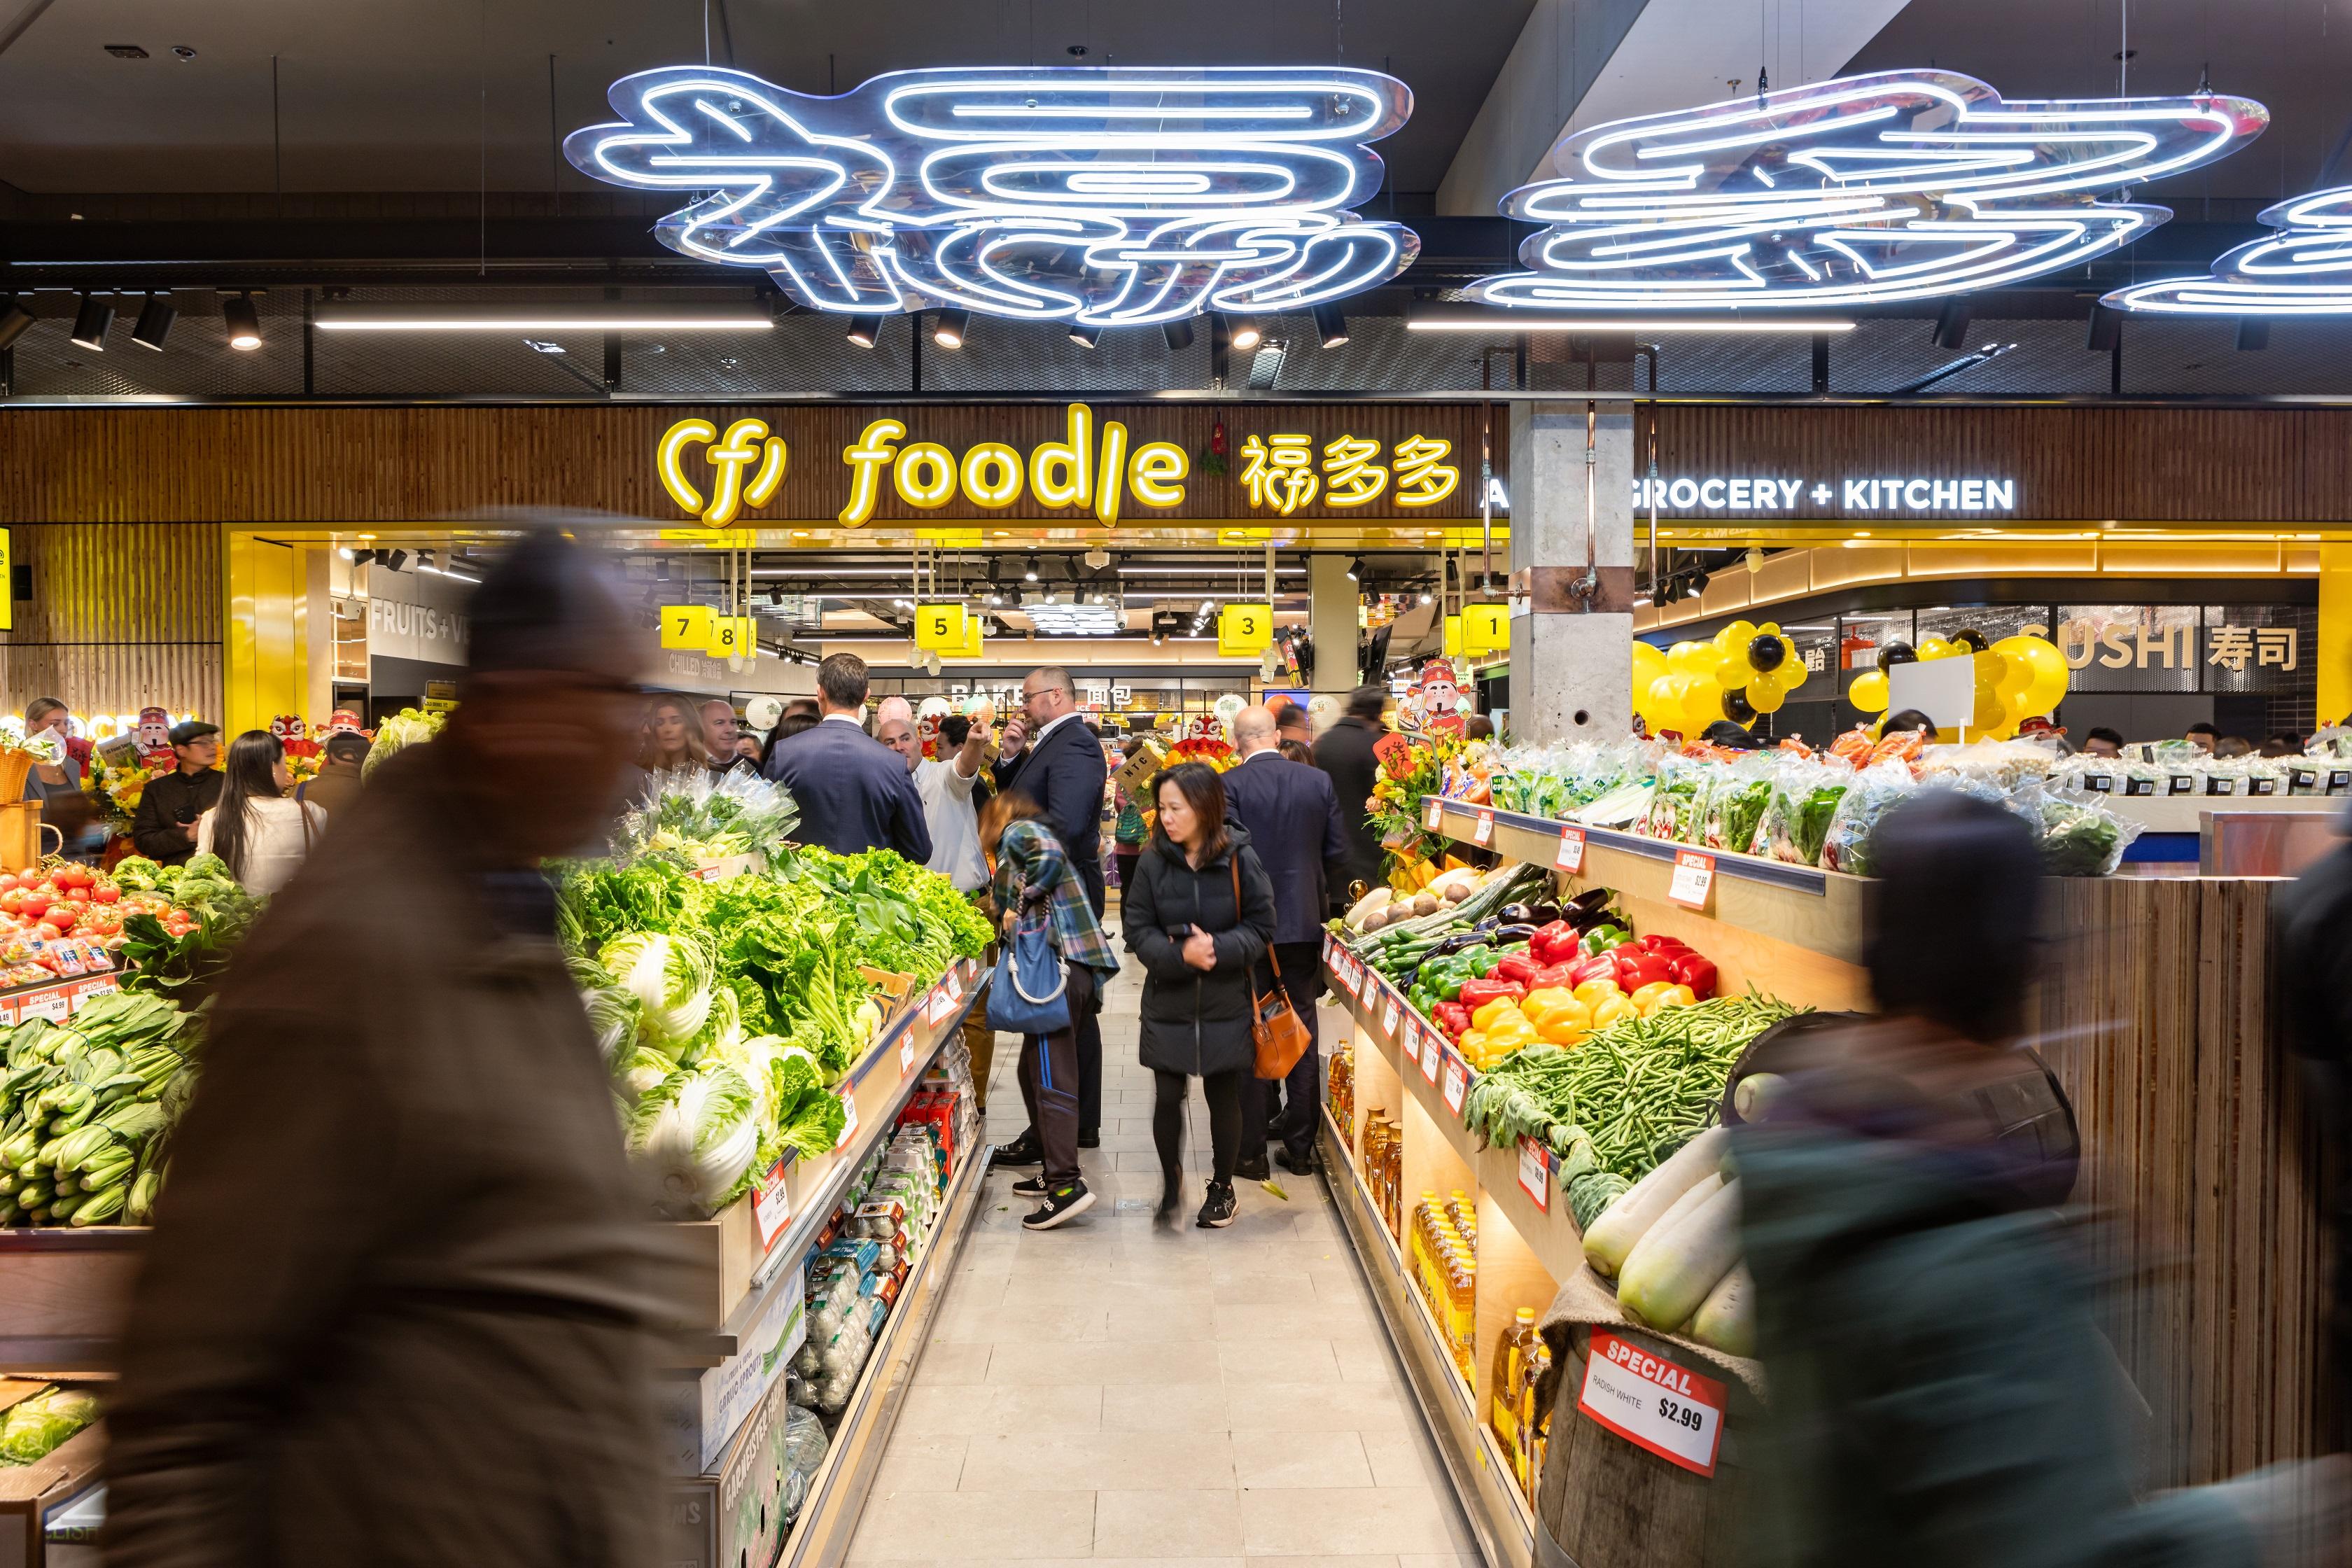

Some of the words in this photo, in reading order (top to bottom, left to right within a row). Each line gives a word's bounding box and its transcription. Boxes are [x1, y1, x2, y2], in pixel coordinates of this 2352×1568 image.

[838, 402, 1190, 529] foodle
[1240, 434, 1460, 517] 福多多
[1844, 479, 2013, 510] KITCHEN
[370, 597, 438, 640] FRUITS
[677, 618, 690, 636] 7
[934, 618, 948, 636] 5
[1242, 617, 1255, 635] 3
[1490, 617, 1497, 635] 1
[721, 629, 734, 645] 8
[2208, 624, 2297, 671] 寿司
[668, 652, 700, 676] CHILLED
[1086, 685, 1133, 706] 面包
[1681, 853, 1707, 869] SPECIAL
[1695, 875, 1707, 888] $2.99
[78, 979, 107, 993] SPECIAL
[29, 990, 61, 1004] SPECIAL
[52, 1001, 65, 1011] $4.99
[1606, 1340, 1692, 1396] SPECIAL
[719, 1382, 739, 1414] GARLIC
[739, 1352, 762, 1392] SPROUTS
[1592, 1374, 1616, 1396] RADISH
[1616, 1389, 1642, 1410] WHITE
[1658, 1397, 1703, 1432] $2.99
